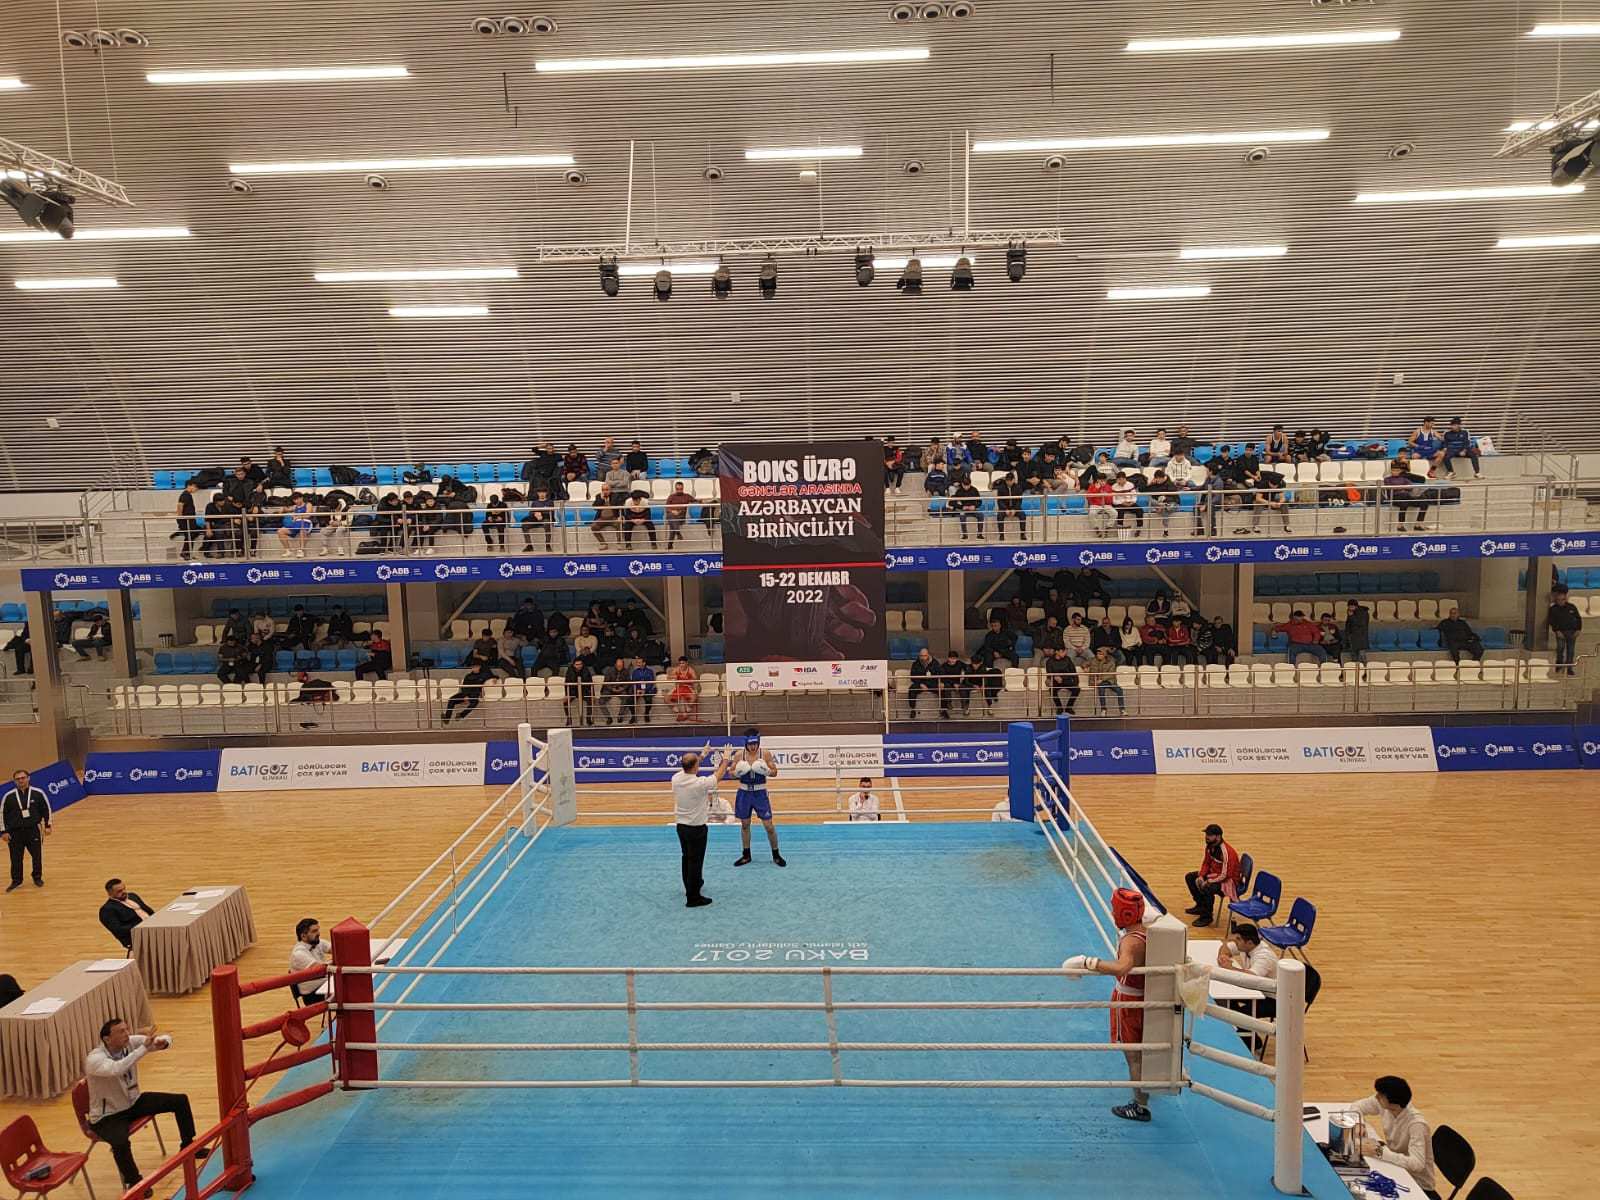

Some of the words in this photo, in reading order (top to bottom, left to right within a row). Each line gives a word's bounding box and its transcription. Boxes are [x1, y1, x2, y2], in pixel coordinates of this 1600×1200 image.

[743, 459, 799, 483] BOKS
[803, 455, 856, 482] ÜZRƏ
[738, 485, 797, 497] GƏNCLƏR
[799, 483, 862, 495] ARASINDA
[738, 498, 862, 516] AZƏRBAYCAN
[747, 516, 855, 538] BİRİNCİLİYİ
[759, 572, 796, 587] 15-22
[798, 571, 850, 586] DEKABR
[786, 590, 823, 603] 2022
[690, 949, 774, 961] 2017
[785, 949, 869, 961] BAKU
